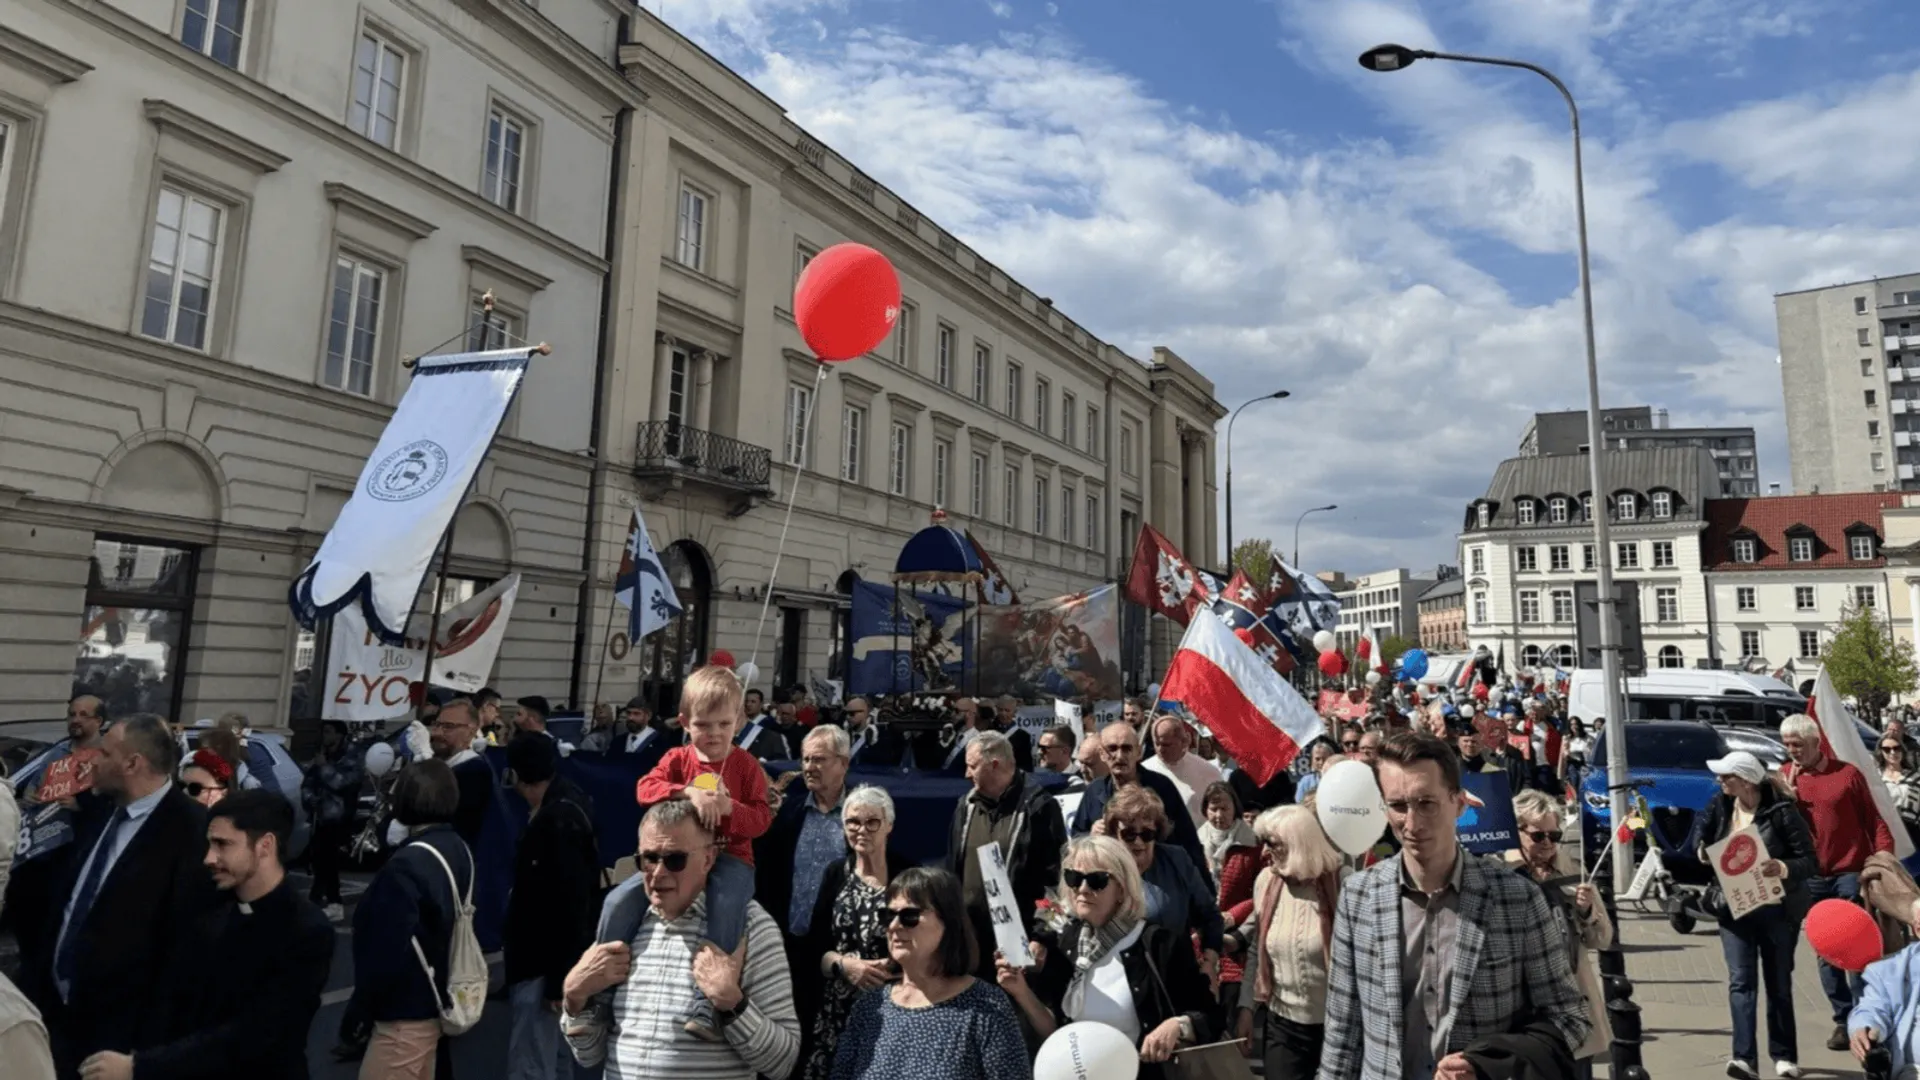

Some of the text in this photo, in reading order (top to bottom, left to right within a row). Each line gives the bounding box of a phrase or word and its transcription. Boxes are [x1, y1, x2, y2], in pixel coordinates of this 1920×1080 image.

[379, 649, 413, 671] dla
[334, 665, 410, 706] ŻYC
[1480, 830, 1511, 841] POLSKI
